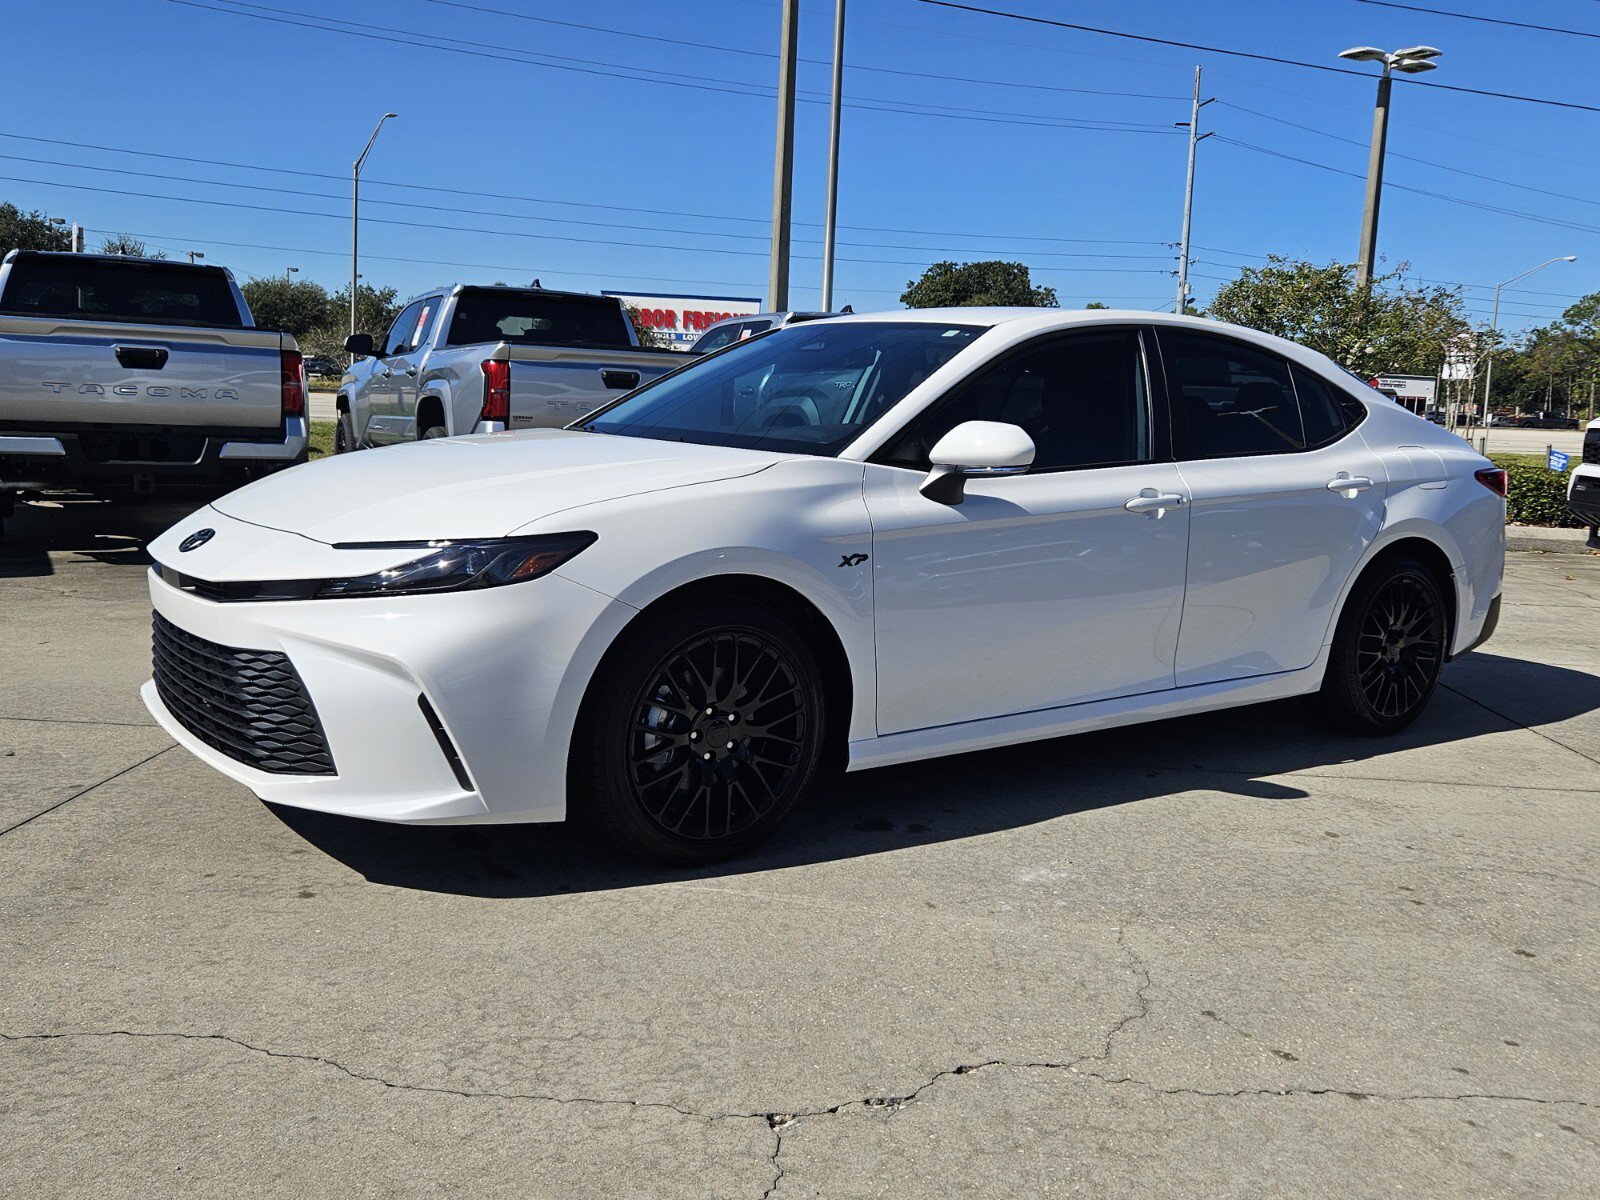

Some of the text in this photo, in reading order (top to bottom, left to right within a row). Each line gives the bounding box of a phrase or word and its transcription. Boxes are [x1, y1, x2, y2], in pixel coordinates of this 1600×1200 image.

[631, 307, 677, 329] BOR
[42, 381, 240, 400] TACOMA
[838, 553, 869, 567] XP
